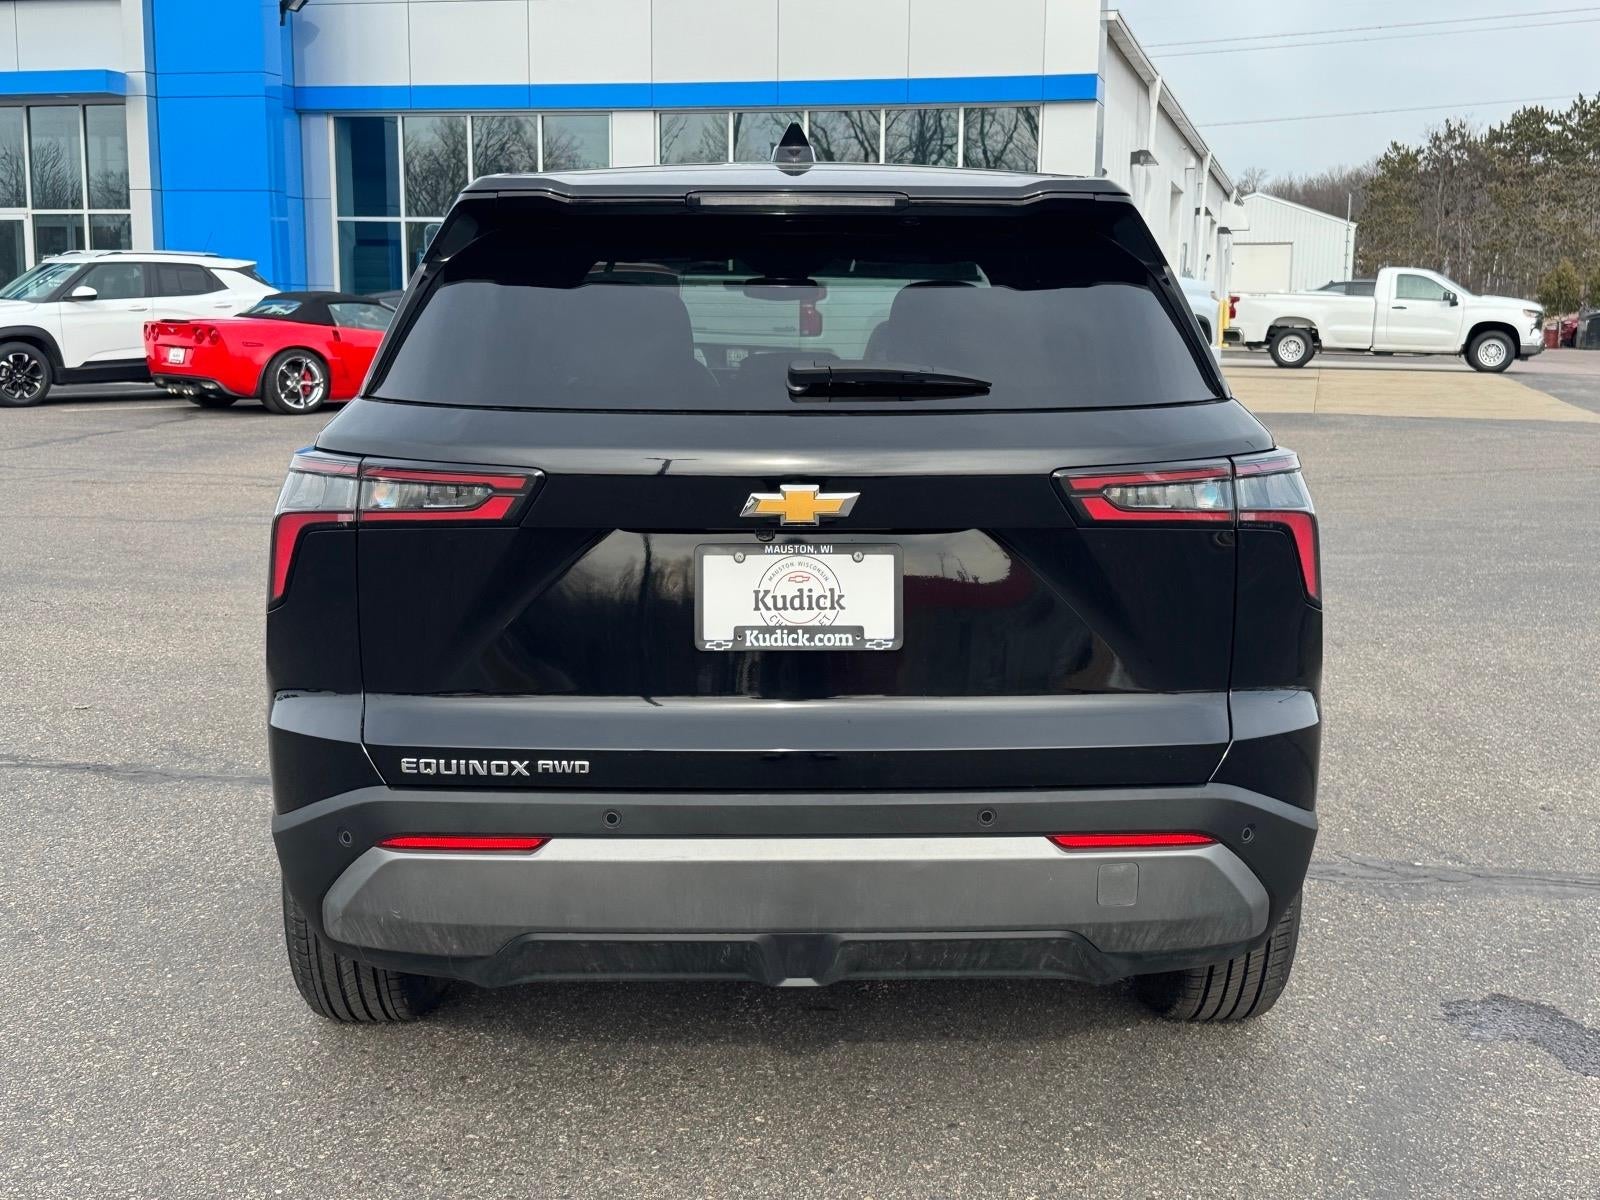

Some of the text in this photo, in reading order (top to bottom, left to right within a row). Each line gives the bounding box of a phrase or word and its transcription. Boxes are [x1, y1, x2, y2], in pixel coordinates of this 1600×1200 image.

[764, 545, 833, 555] MAUSTON, WI
[768, 561, 830, 582] MAUSTON WISCONSIN
[753, 588, 846, 611] Kudick
[745, 629, 854, 647] Kudick.com
[401, 758, 590, 776] EQUINOX AWD
